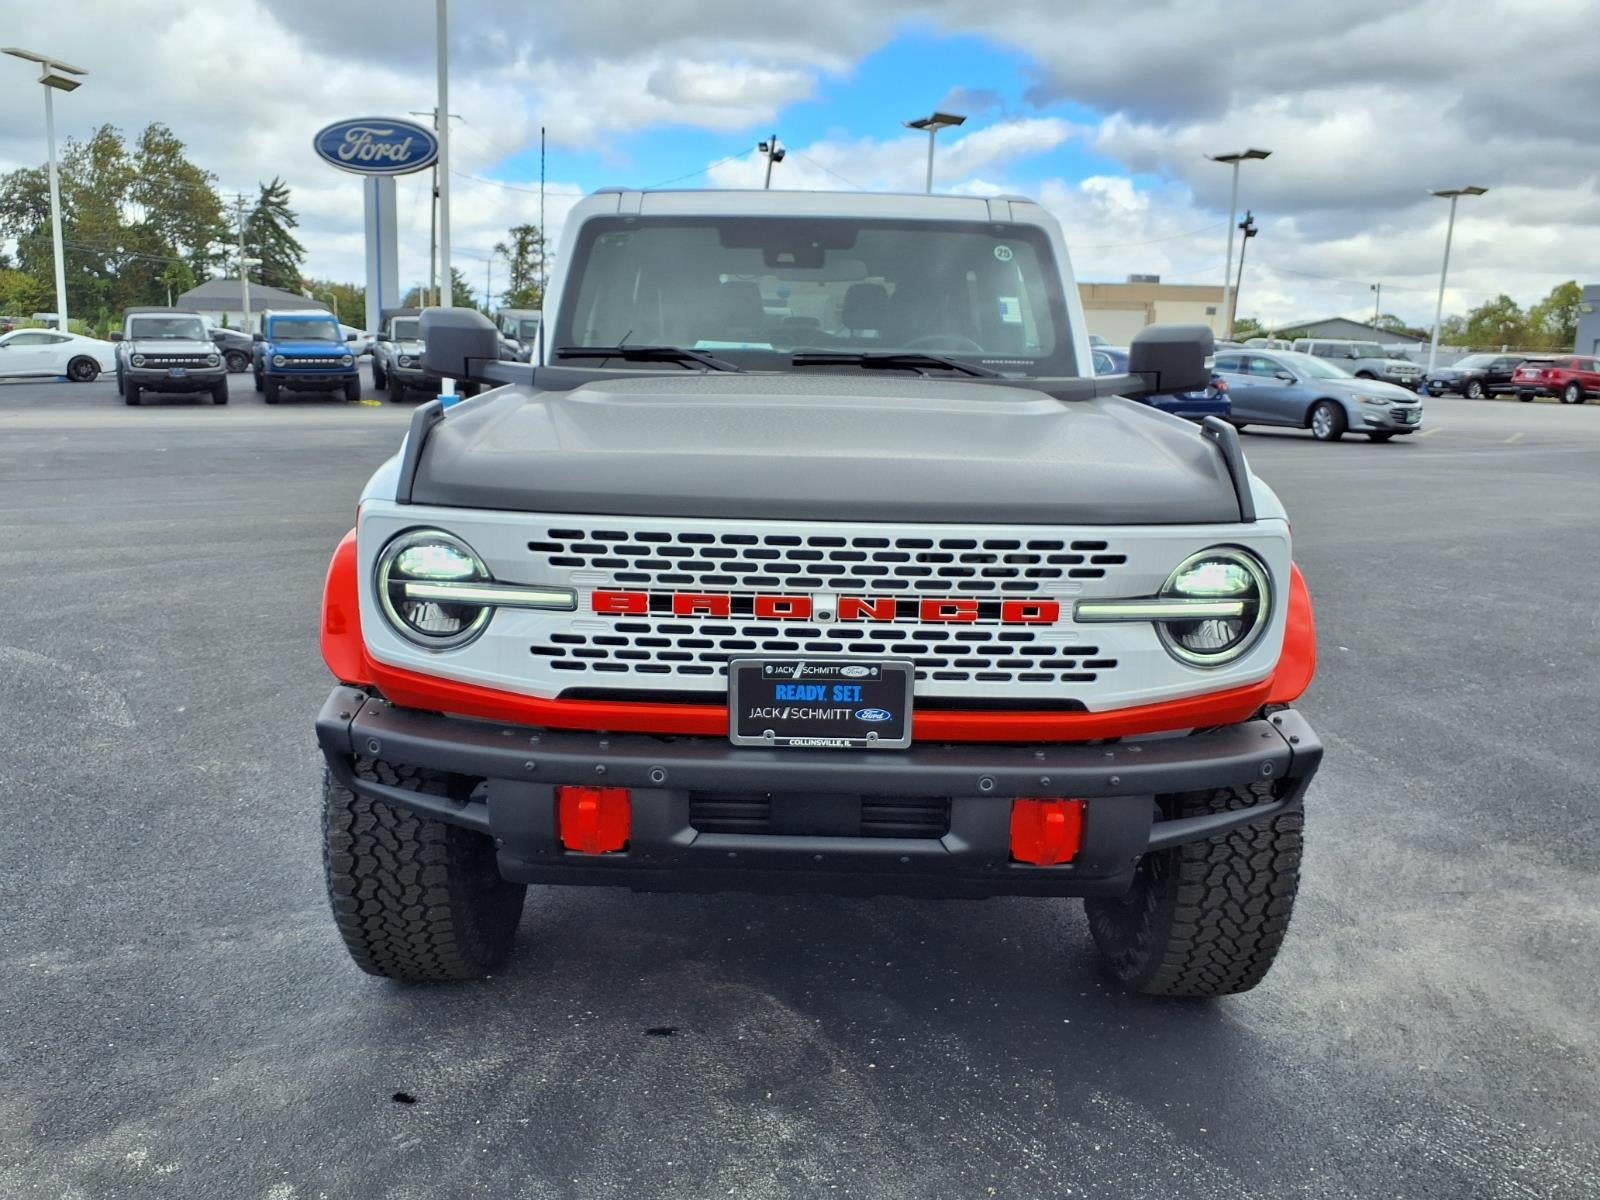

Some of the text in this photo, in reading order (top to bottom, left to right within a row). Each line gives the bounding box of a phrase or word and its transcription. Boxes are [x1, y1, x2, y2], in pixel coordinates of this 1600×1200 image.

[338, 127, 413, 161] Ford
[591, 590, 1060, 622] BRONCO
[789, 739, 844, 747] COLLINSVILLE,
